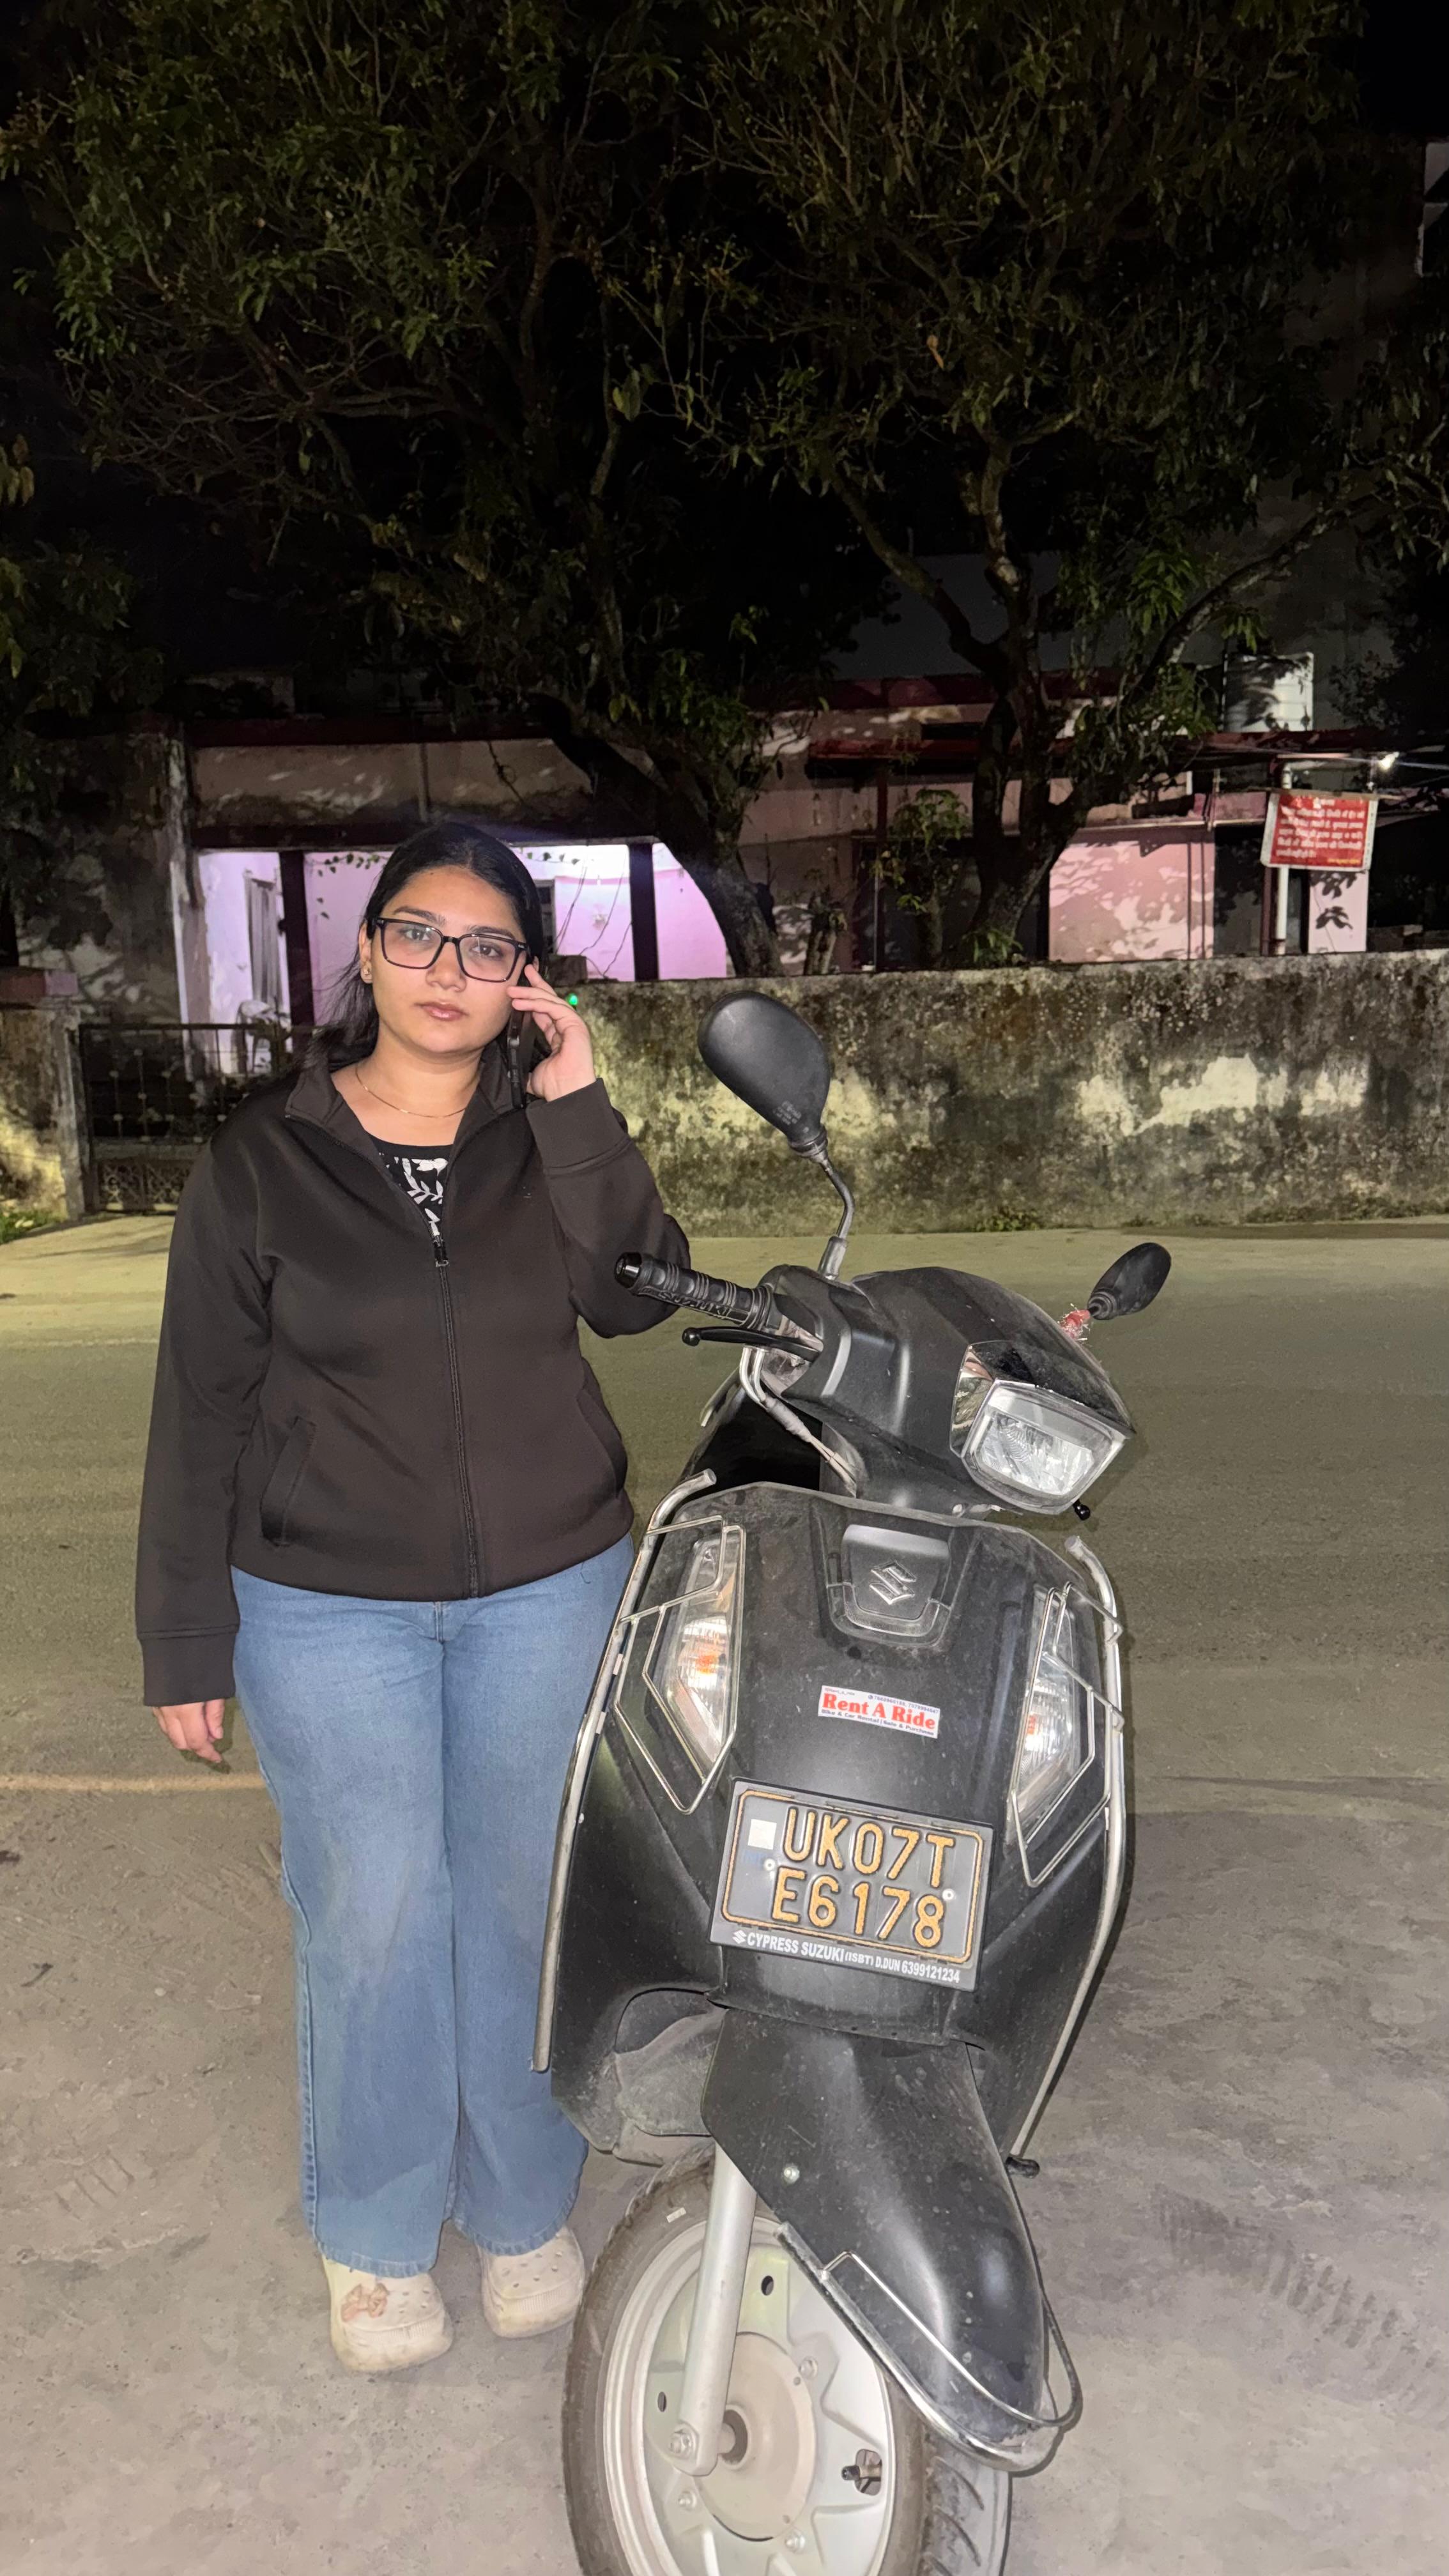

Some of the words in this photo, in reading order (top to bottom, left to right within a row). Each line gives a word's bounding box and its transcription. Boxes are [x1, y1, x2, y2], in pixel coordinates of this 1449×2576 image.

[822, 1693, 870, 1715] Rent
[872, 1702, 887, 1718] A
[891, 1705, 935, 1729] Ride
[857, 1715, 879, 1723] Rental
[783, 1807, 956, 1889] UK07T
[772, 1866, 945, 1949] E6178
[747, 1932, 799, 1954] CYPRESS
[801, 1942, 845, 1962] SUZUKI
[845, 1951, 873, 1966] (ISBT)
[875, 1956, 901, 1972] D.DUN
[901, 1960, 960, 1983] 6399121234
